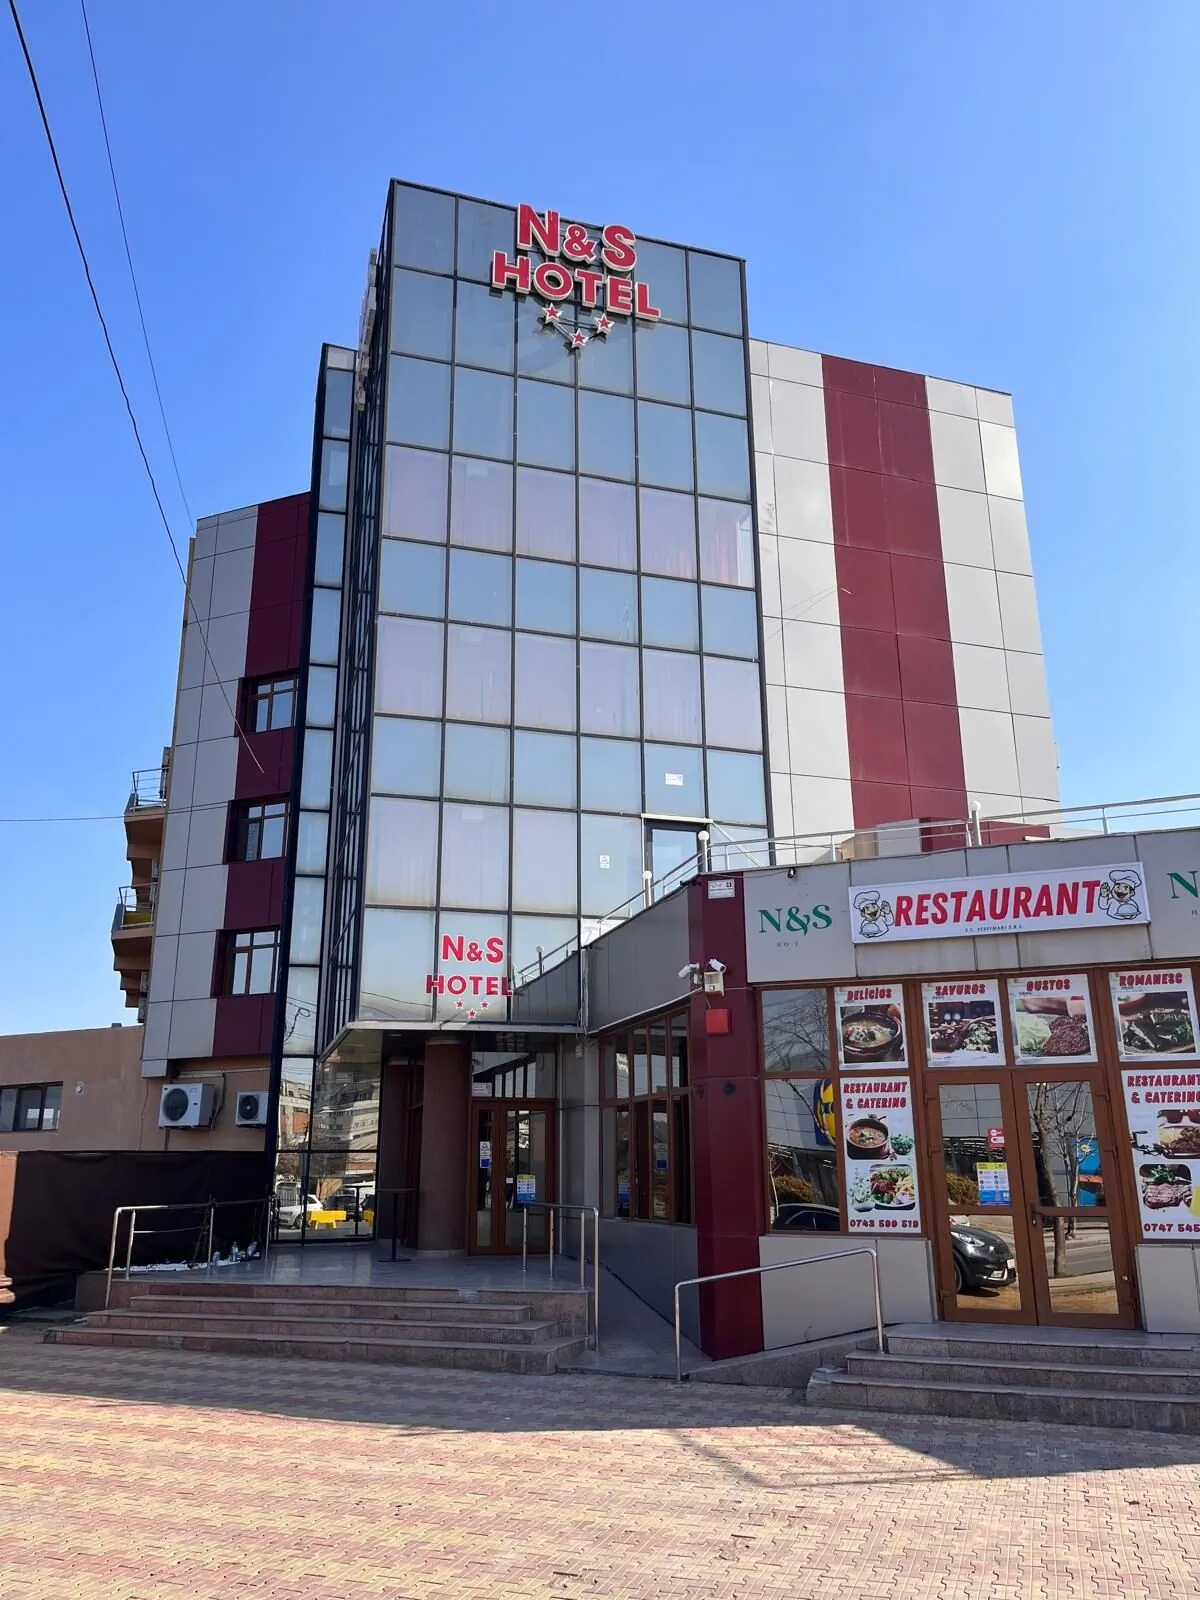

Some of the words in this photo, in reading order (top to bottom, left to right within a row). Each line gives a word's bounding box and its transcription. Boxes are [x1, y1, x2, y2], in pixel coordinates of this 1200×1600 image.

[517, 203, 637, 272] N&S
[492, 250, 661, 321] HOTEL
[894, 879, 1101, 926] RESTAURANT
[758, 904, 833, 936] N&S
[441, 934, 504, 964] N&S
[425, 974, 513, 996] HOTEL
[1026, 979, 1071, 991] GUSTOS
[1119, 973, 1183, 986] ROMANESC
[935, 984, 986, 996] SAVUROS
[843, 1082, 907, 1094] RESTAURANT
[845, 1098, 853, 1109] &
[857, 1097, 907, 1109] CATERING
[1131, 1091, 1140, 1104] &
[1143, 1223, 1174, 1232] 0747
